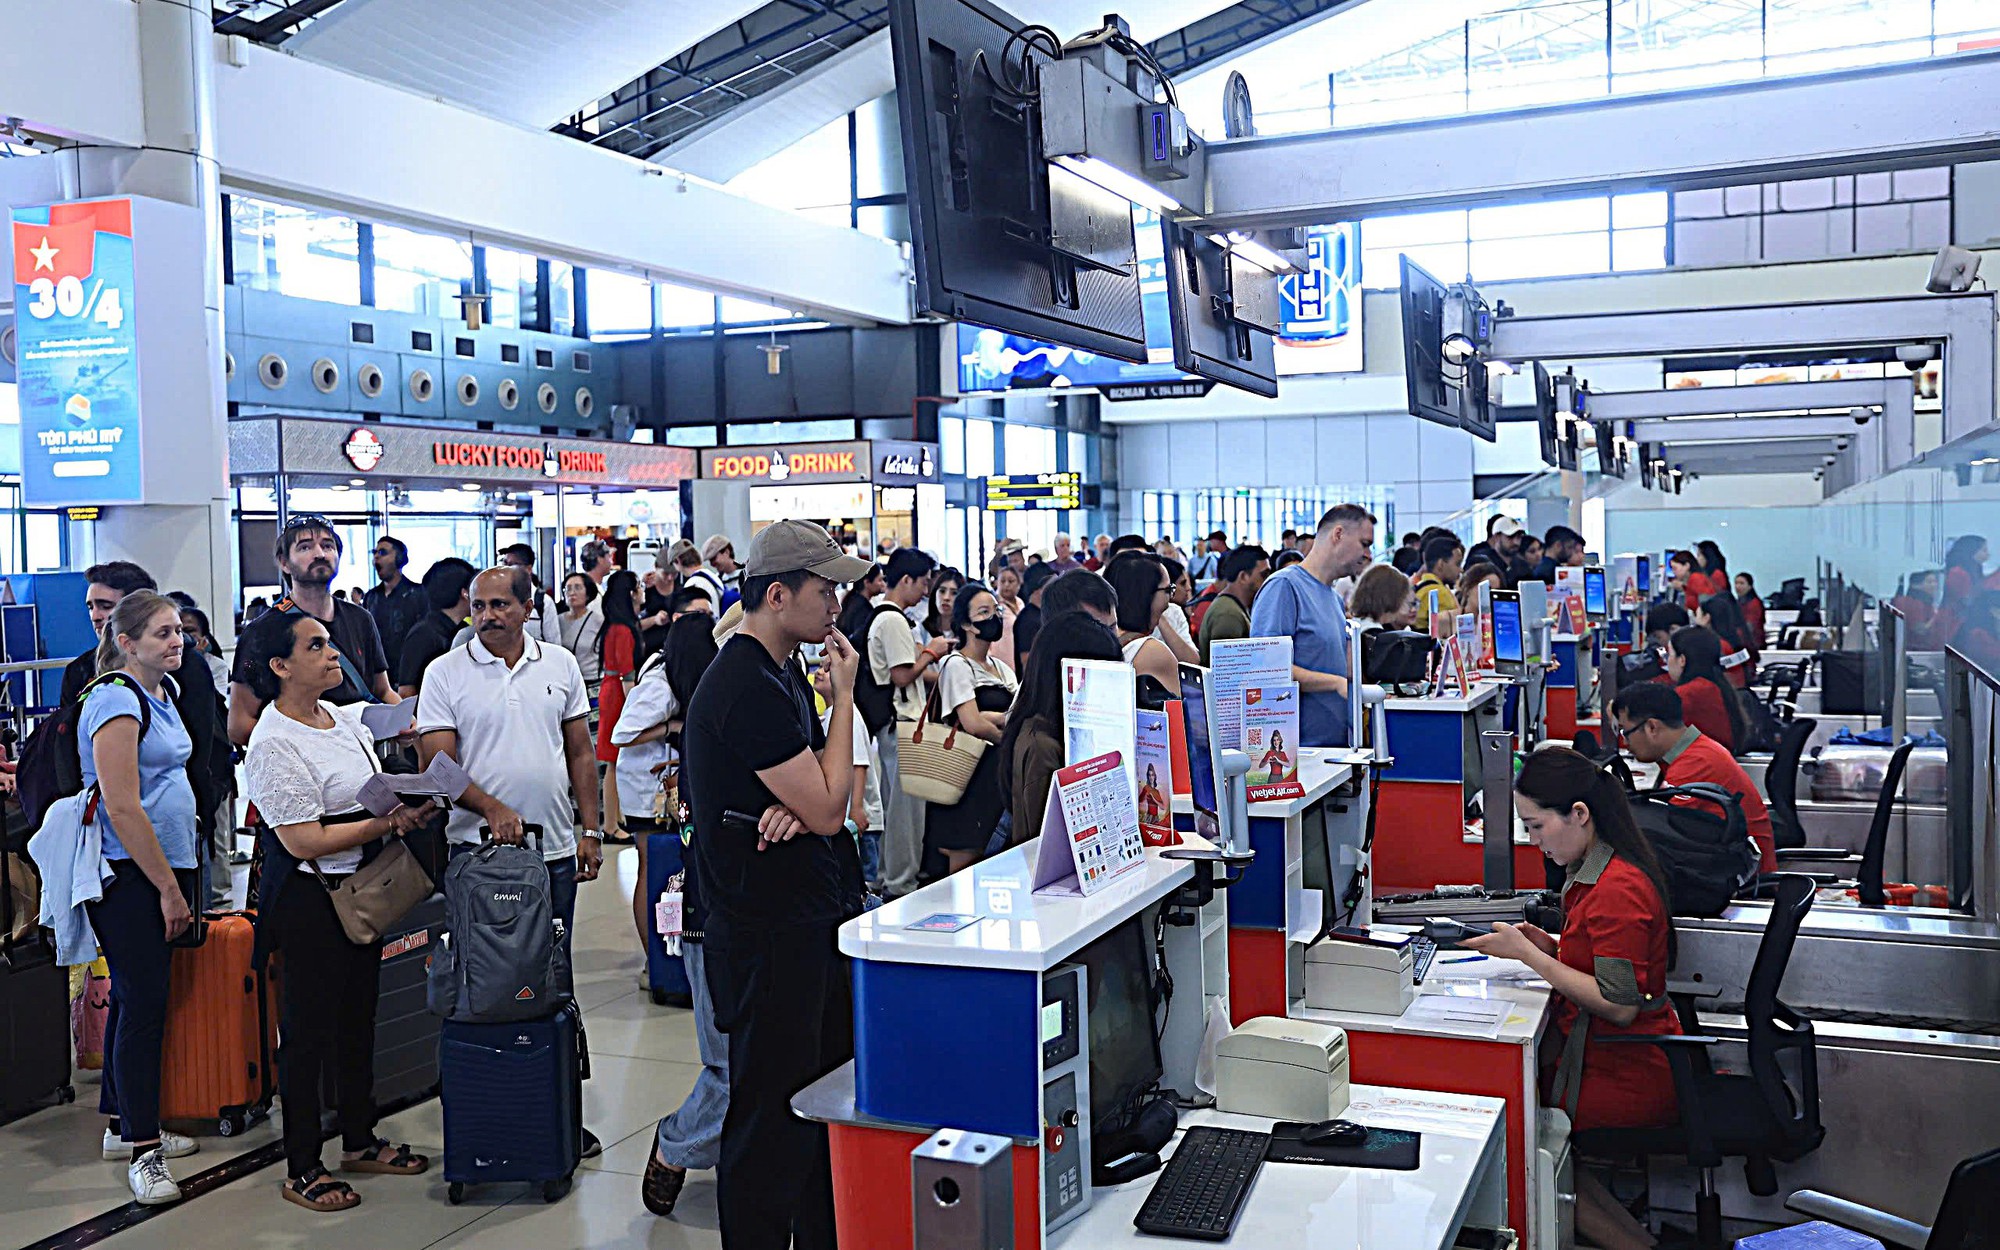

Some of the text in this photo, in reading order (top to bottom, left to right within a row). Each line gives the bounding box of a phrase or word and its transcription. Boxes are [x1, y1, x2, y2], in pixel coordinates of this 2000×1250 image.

[28, 275, 124, 330] 30/4
[433, 441, 608, 473] LUCKY FOOD DRINK
[712, 455, 771, 478] FOOD
[788, 451, 857, 474] DRINK
[493, 891, 522, 902] emmi
